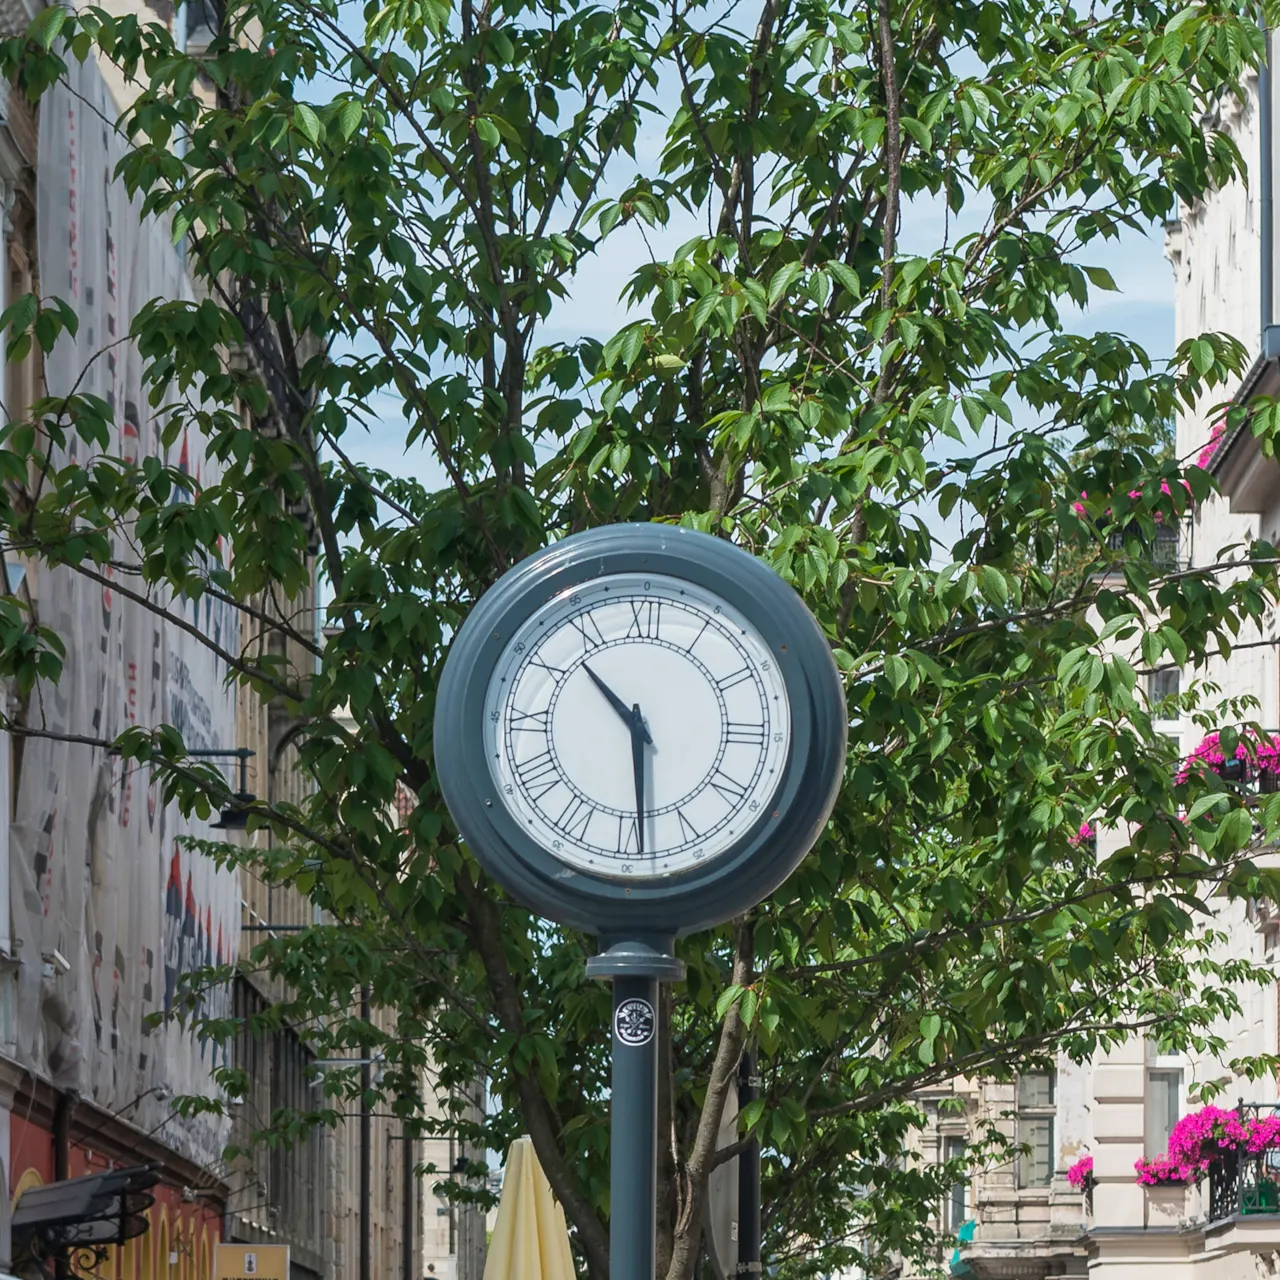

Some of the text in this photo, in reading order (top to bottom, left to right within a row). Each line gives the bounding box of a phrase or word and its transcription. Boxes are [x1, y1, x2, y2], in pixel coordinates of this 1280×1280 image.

[569, 594, 583, 607] 55
[625, 600, 663, 640] XII
[513, 642, 527, 656] 50
[760, 659, 771, 673] 10
[489, 710, 501, 725] 45
[773, 732, 784, 744] 15
[503, 784, 514, 797] 40
[748, 799, 761, 813] 20
[551, 840, 565, 852] 35
[692, 847, 706, 861] 25
[621, 863, 635, 874] 30
